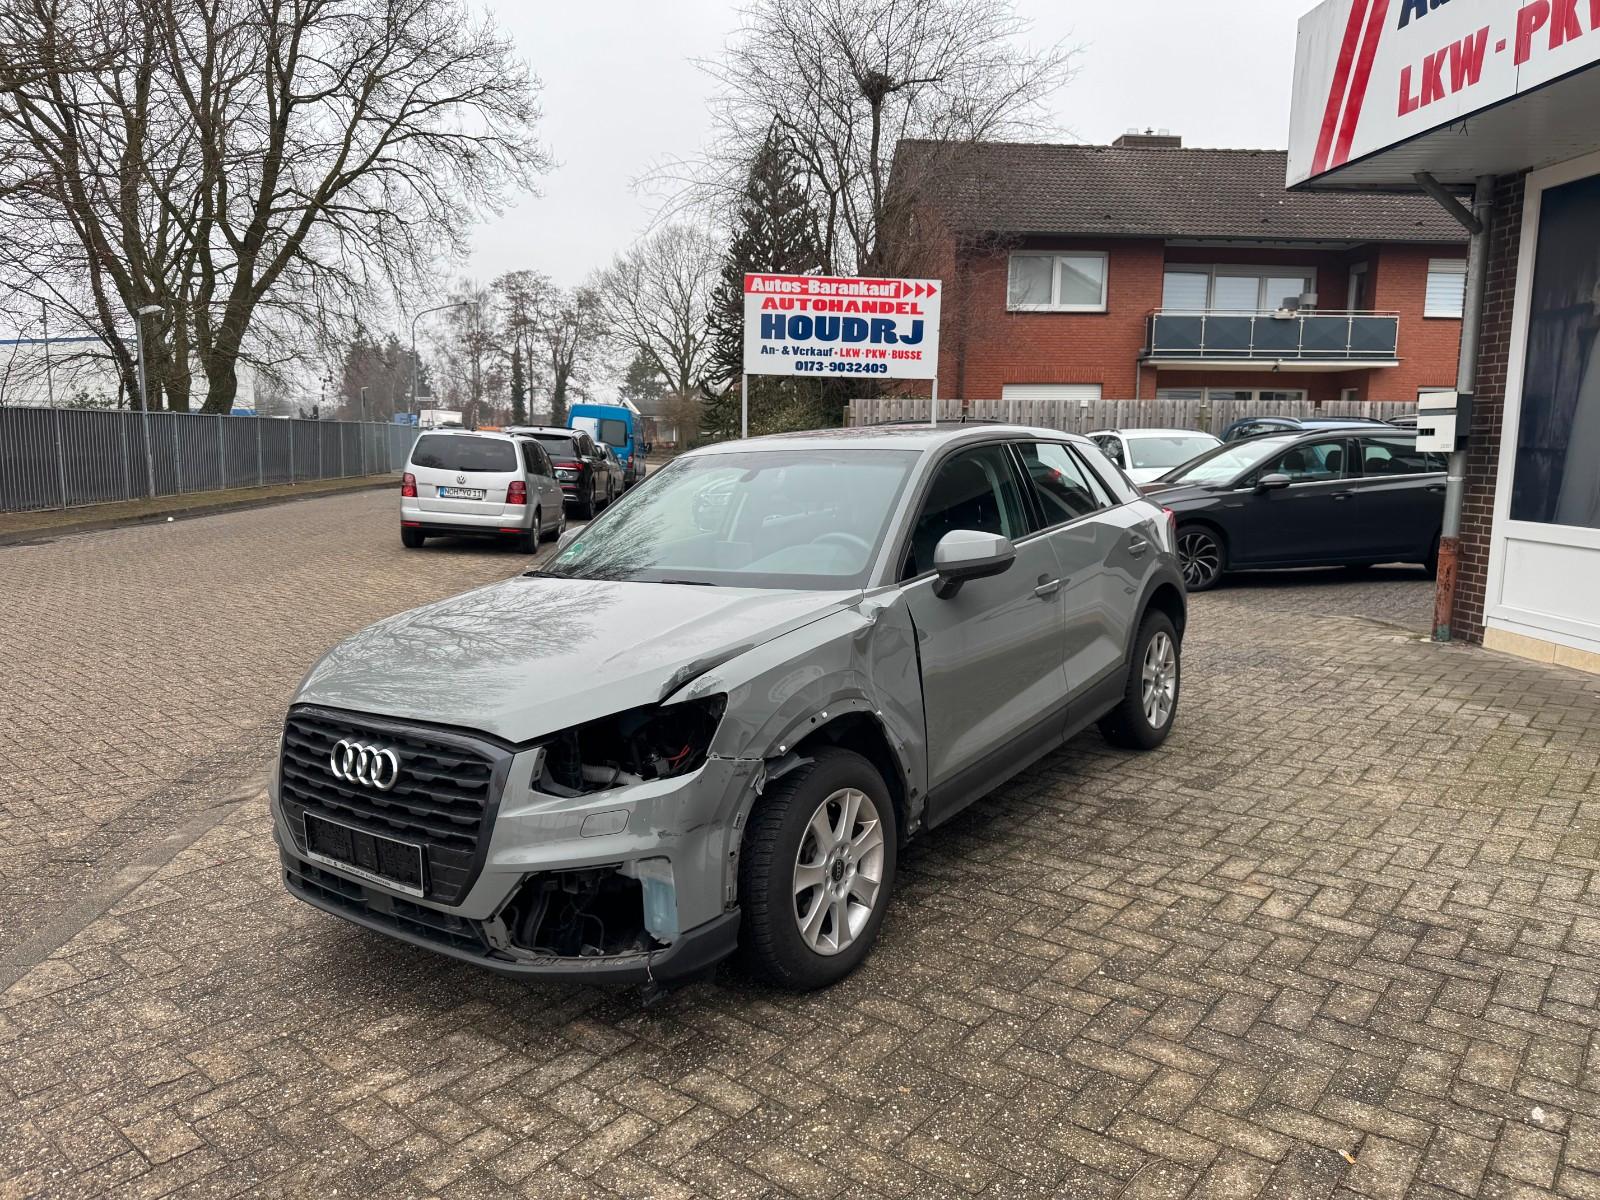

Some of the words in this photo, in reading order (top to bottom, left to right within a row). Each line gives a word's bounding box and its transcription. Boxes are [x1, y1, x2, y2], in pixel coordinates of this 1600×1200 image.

[1398, 25, 1490, 117] LKW
[1513, 0, 1600, 66] PK
[751, 277, 898, 297] Autos-Barankauf
[761, 297, 924, 315] AUTOHANDEL
[760, 313, 924, 344] HOUDRJ
[781, 346, 790, 355] &
[791, 346, 834, 357] Verkauf
[839, 348, 861, 358] LKW
[865, 349, 887, 359] PKW
[891, 350, 922, 360] BUSSE
[795, 360, 888, 374] 0173-9032409
